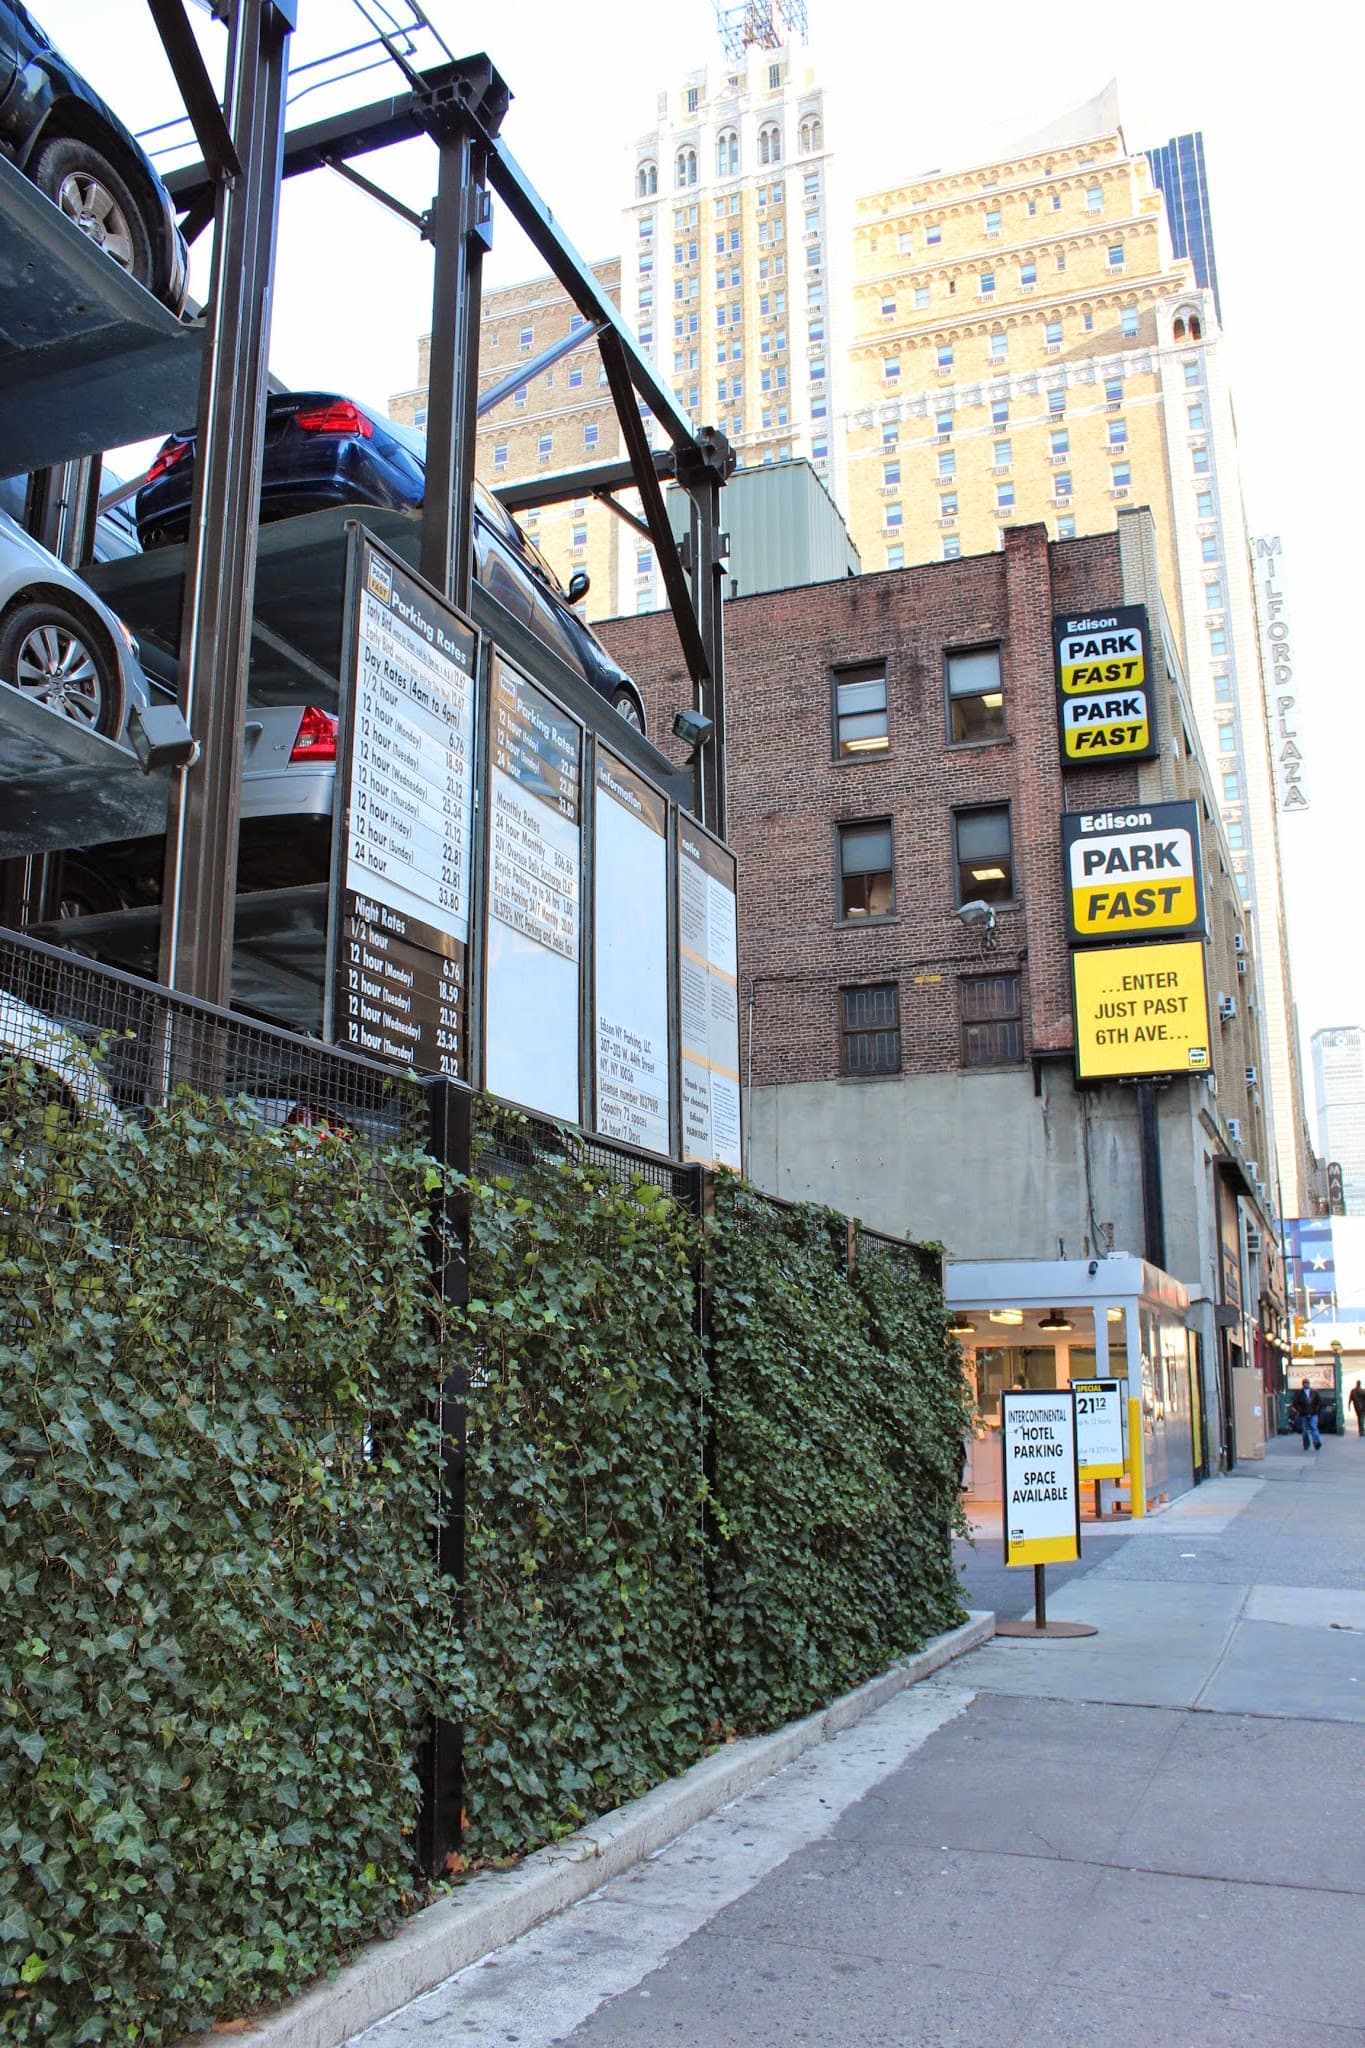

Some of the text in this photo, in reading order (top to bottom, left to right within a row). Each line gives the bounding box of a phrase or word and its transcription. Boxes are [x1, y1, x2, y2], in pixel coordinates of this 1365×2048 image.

[382, 611, 393, 633] Bird
[392, 591, 434, 642] Parking
[437, 628, 466, 665] Rates
[1067, 617, 1117, 633] Edison
[1069, 634, 1137, 660] PARK
[1071, 661, 1138, 686] FAST
[1255, 536, 1308, 807] MILFORD PLAZA
[365, 646, 381, 673] Day
[384, 660, 407, 690] Rates
[409, 677, 429, 705] (4am
[432, 696, 440, 713] to
[442, 703, 460, 730] 4pm)
[363, 669, 377, 692] 1/2
[380, 680, 398, 707] hour
[449, 732, 464, 755] 6.76
[498, 708, 506, 727] 12
[507, 714, 522, 738] hour
[1072, 697, 1141, 722] PARK
[363, 693, 463, 776] 12 hour (Monday) 18.59
[497, 728, 505, 746] 12
[506, 733, 520, 756] hour
[517, 697, 575, 757] Parking Rates
[1075, 725, 1143, 750] FAST
[362, 716, 462, 800] 12 hour (Tuesday) 21.12
[361, 740, 462, 822] 12 hour (Wednesday) 25.34
[497, 750, 574, 820] 24 hour 33.80
[600, 767, 642, 812] information
[359, 764, 461, 844] 12 hour (Thursday) 21.12
[496, 791, 540, 834] Monthly Rates
[358, 790, 462, 868] 12 hour (Friday) 22.81
[495, 812, 504, 832] 24
[506, 818, 520, 841] hour
[522, 831, 546, 861] Monthly
[1080, 812, 1152, 832] Edison
[356, 815, 460, 889] 12 hour (Sunday) 22.81
[681, 839, 700, 860] notice
[1083, 841, 1182, 876] PARK
[355, 841, 459, 912] 24 hour 33.80
[495, 855, 511, 880] Bicycle
[513, 867, 530, 894] Parking
[532, 880, 537, 897] up
[355, 896, 406, 934] Night Rates
[511, 886, 528, 913] Parking
[1088, 886, 1182, 921] FAST
[524, 911, 542, 942] Parking
[351, 917, 460, 981] 1/2 hour 6.76
[350, 942, 459, 1004] 12 hour (Monday) 18.59
[1102, 971, 1178, 993] ...ENTER
[349, 969, 458, 1028] 12 hour (Tuesday) 21.12
[1094, 996, 1188, 1020] JUST PAST
[349, 995, 458, 1052] 12 hour (Wednesday) 25.34
[615, 1026, 623, 1040] NY
[1095, 1024, 1189, 1045] 6TH AVE...
[348, 1022, 458, 1077] 12 hour (Thursday) 21.12
[642, 1056, 655, 1074] Street
[610, 1062, 619, 1075] NY
[600, 1078, 638, 1105] License number
[600, 1098, 622, 1119] Capacity
[631, 1112, 647, 1128] spaces
[601, 1118, 608, 1132] 24
[629, 1128, 640, 1145] Days
[1008, 1409, 1067, 1424] INTERCONTINENTAL
[1022, 1427, 1055, 1441] HOTEL
[1014, 1444, 1064, 1459] PARKING
[1024, 1471, 1056, 1486] SPACE
[1012, 1487, 1068, 1504] AVAILABLE
